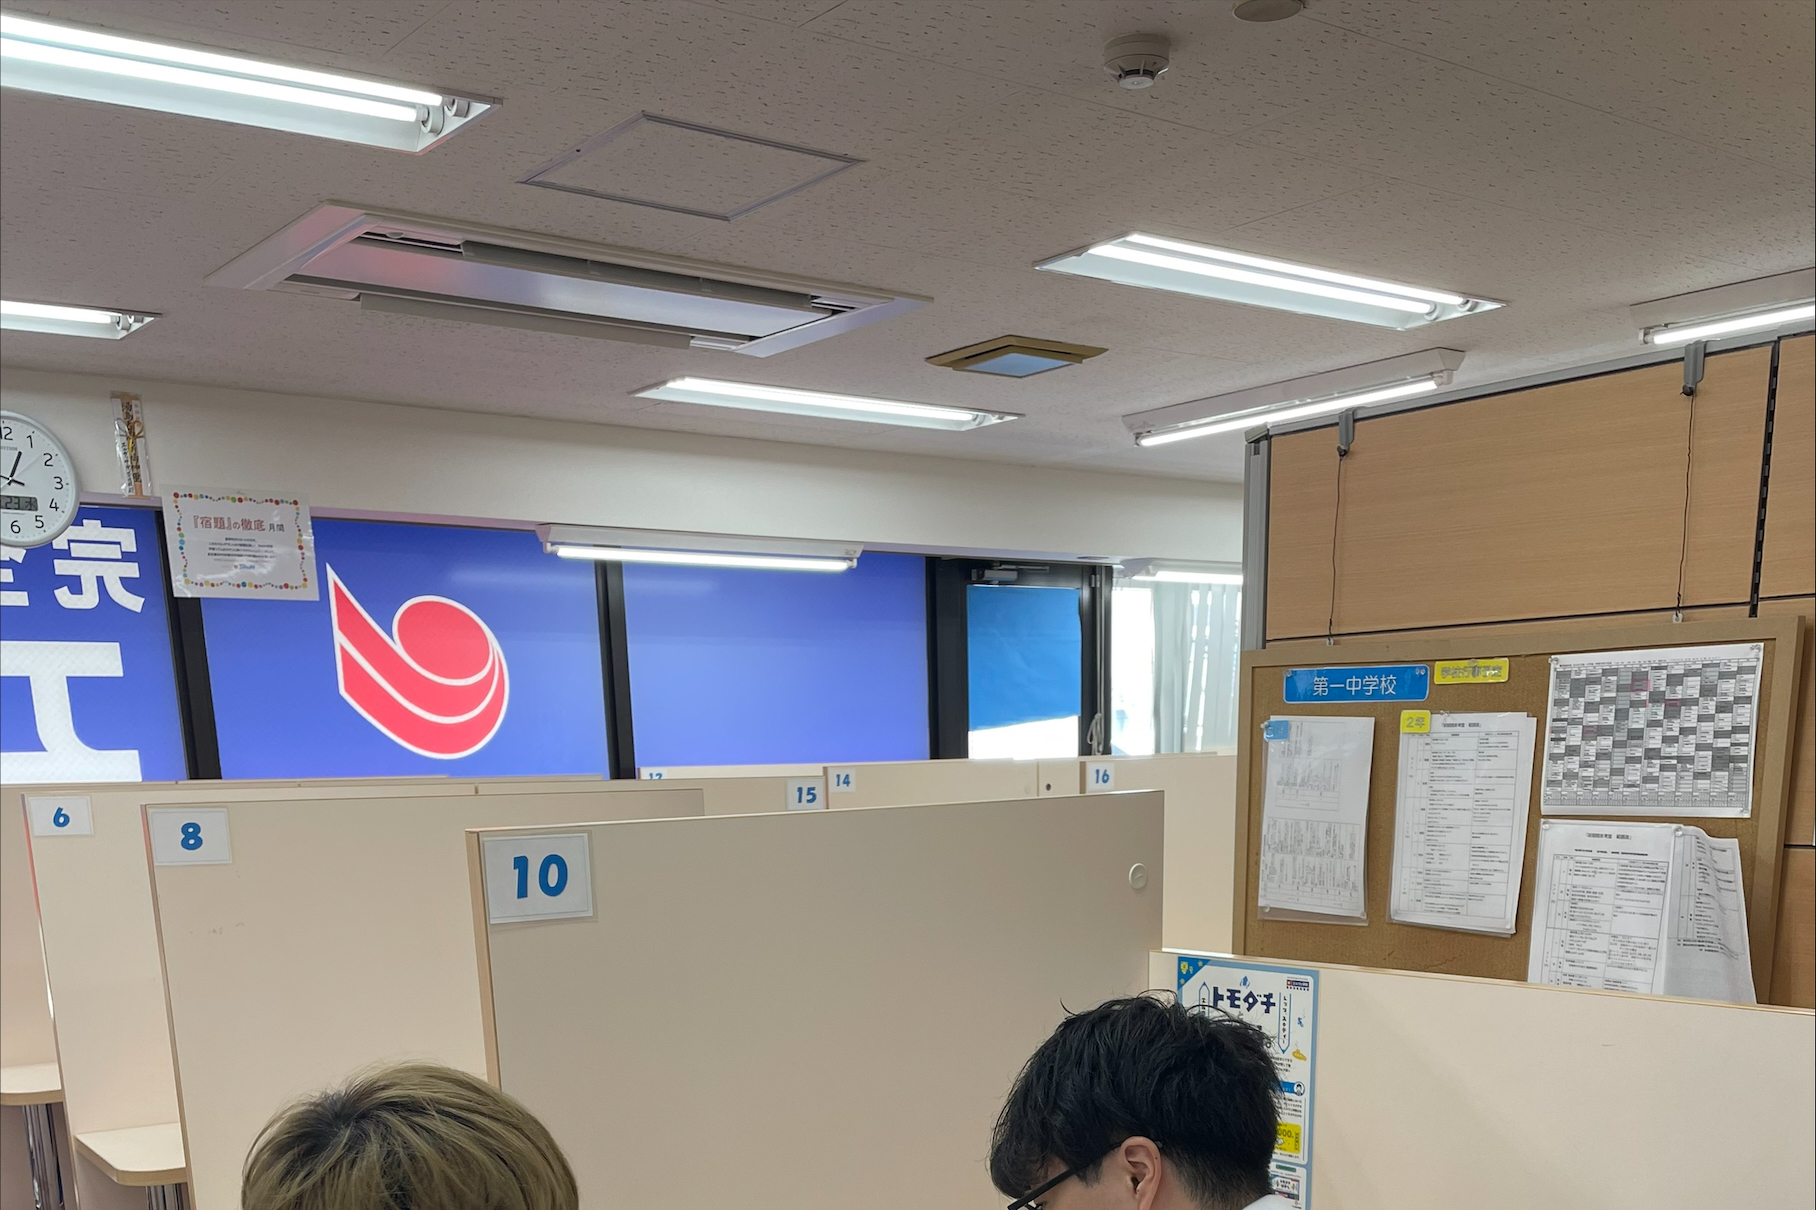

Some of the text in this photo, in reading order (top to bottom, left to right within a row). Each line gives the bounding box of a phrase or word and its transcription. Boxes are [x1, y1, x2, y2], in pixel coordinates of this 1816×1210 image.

[26, 434, 33, 449] 1
[43, 452, 54, 467] 2
[53, 476, 64, 490] 3
[49, 498, 59, 512] 4
[10, 520, 21, 534] 6
[34, 515, 45, 529] 5
[1441, 665, 1503, 680] 学校行予定
[1312, 674, 1397, 697] 第一中学校
[835, 774, 851, 787] 14
[1095, 769, 1110, 784] 16
[797, 786, 817, 804] 15
[53, 807, 70, 828] 6
[180, 822, 203, 850] 8
[513, 853, 568, 899] 10
